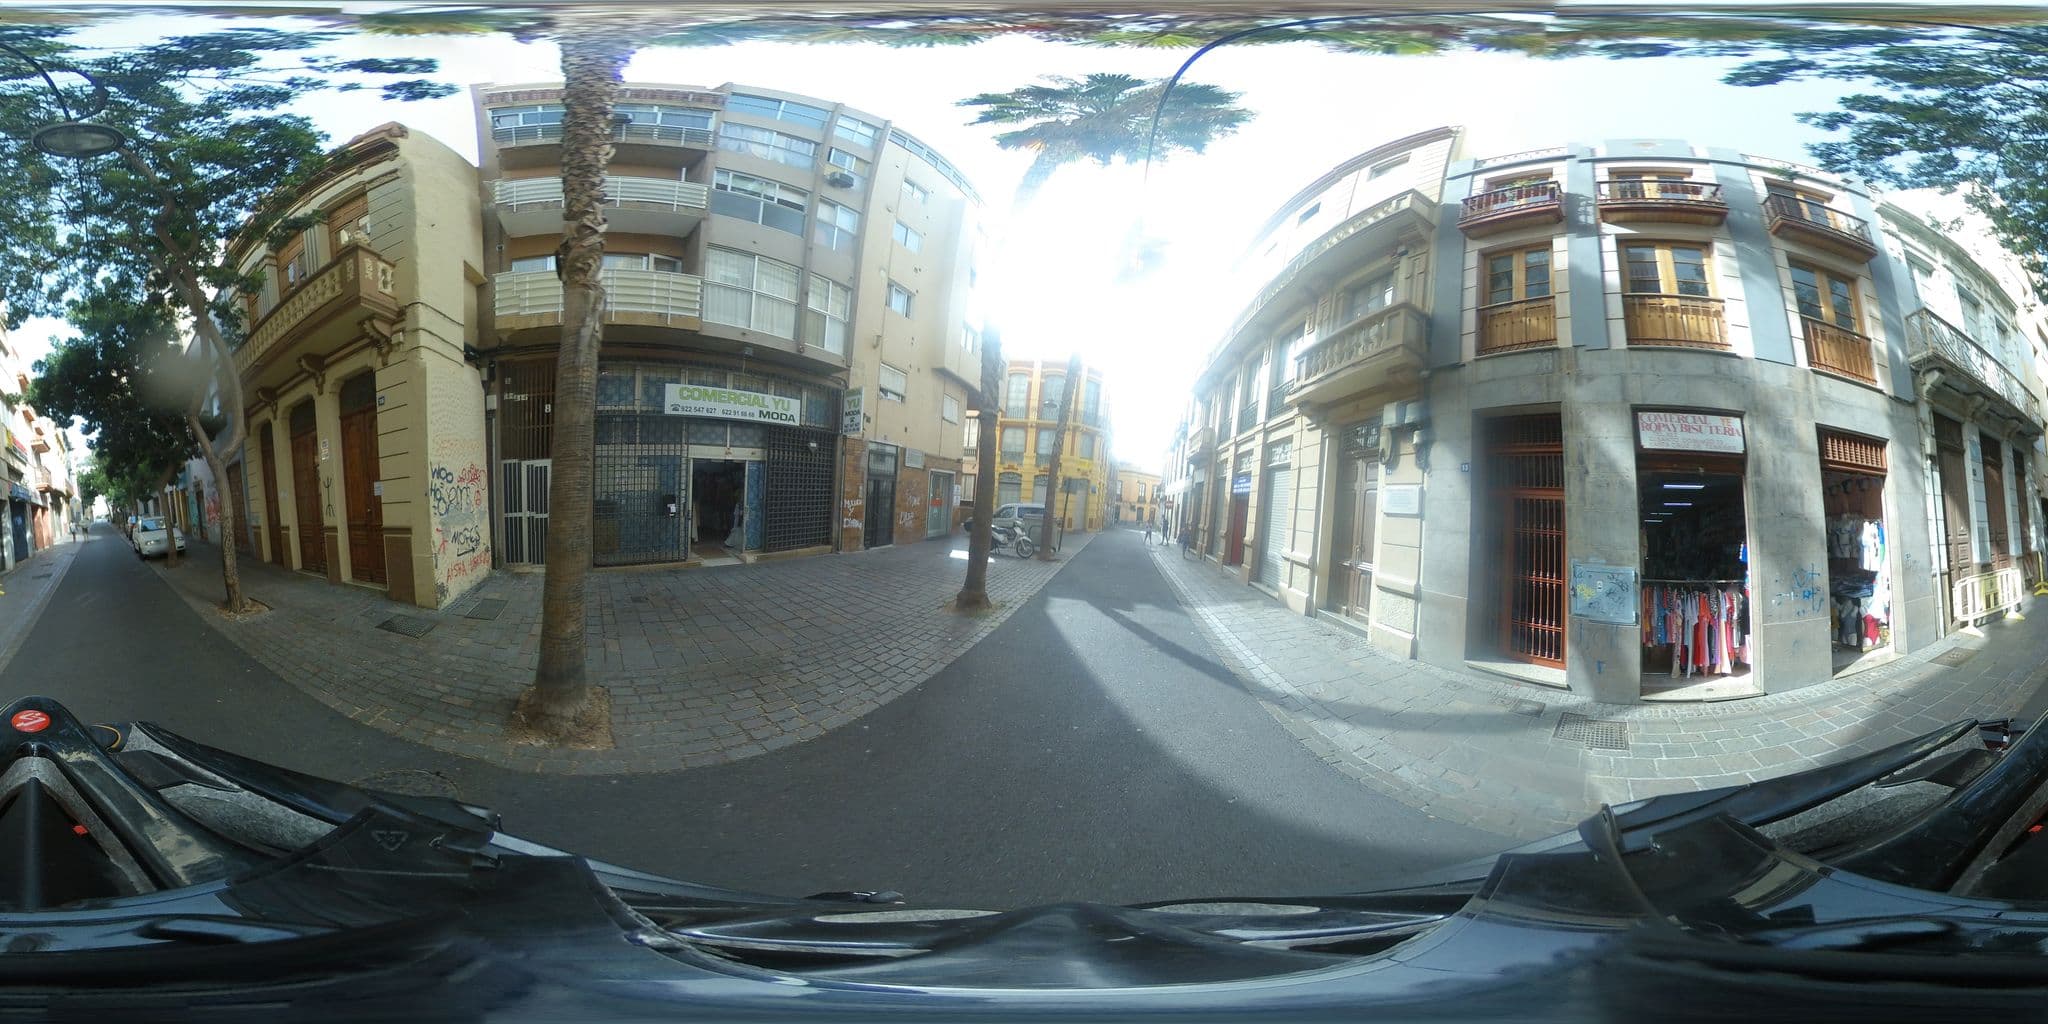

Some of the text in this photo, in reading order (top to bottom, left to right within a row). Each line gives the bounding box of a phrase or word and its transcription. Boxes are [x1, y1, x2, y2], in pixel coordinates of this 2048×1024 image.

[678, 386, 791, 411] COMERCIAL YU
[544, 403, 551, 413] 8
[759, 410, 796, 422] MODA
[1640, 413, 1707, 425] COMERCIAL
